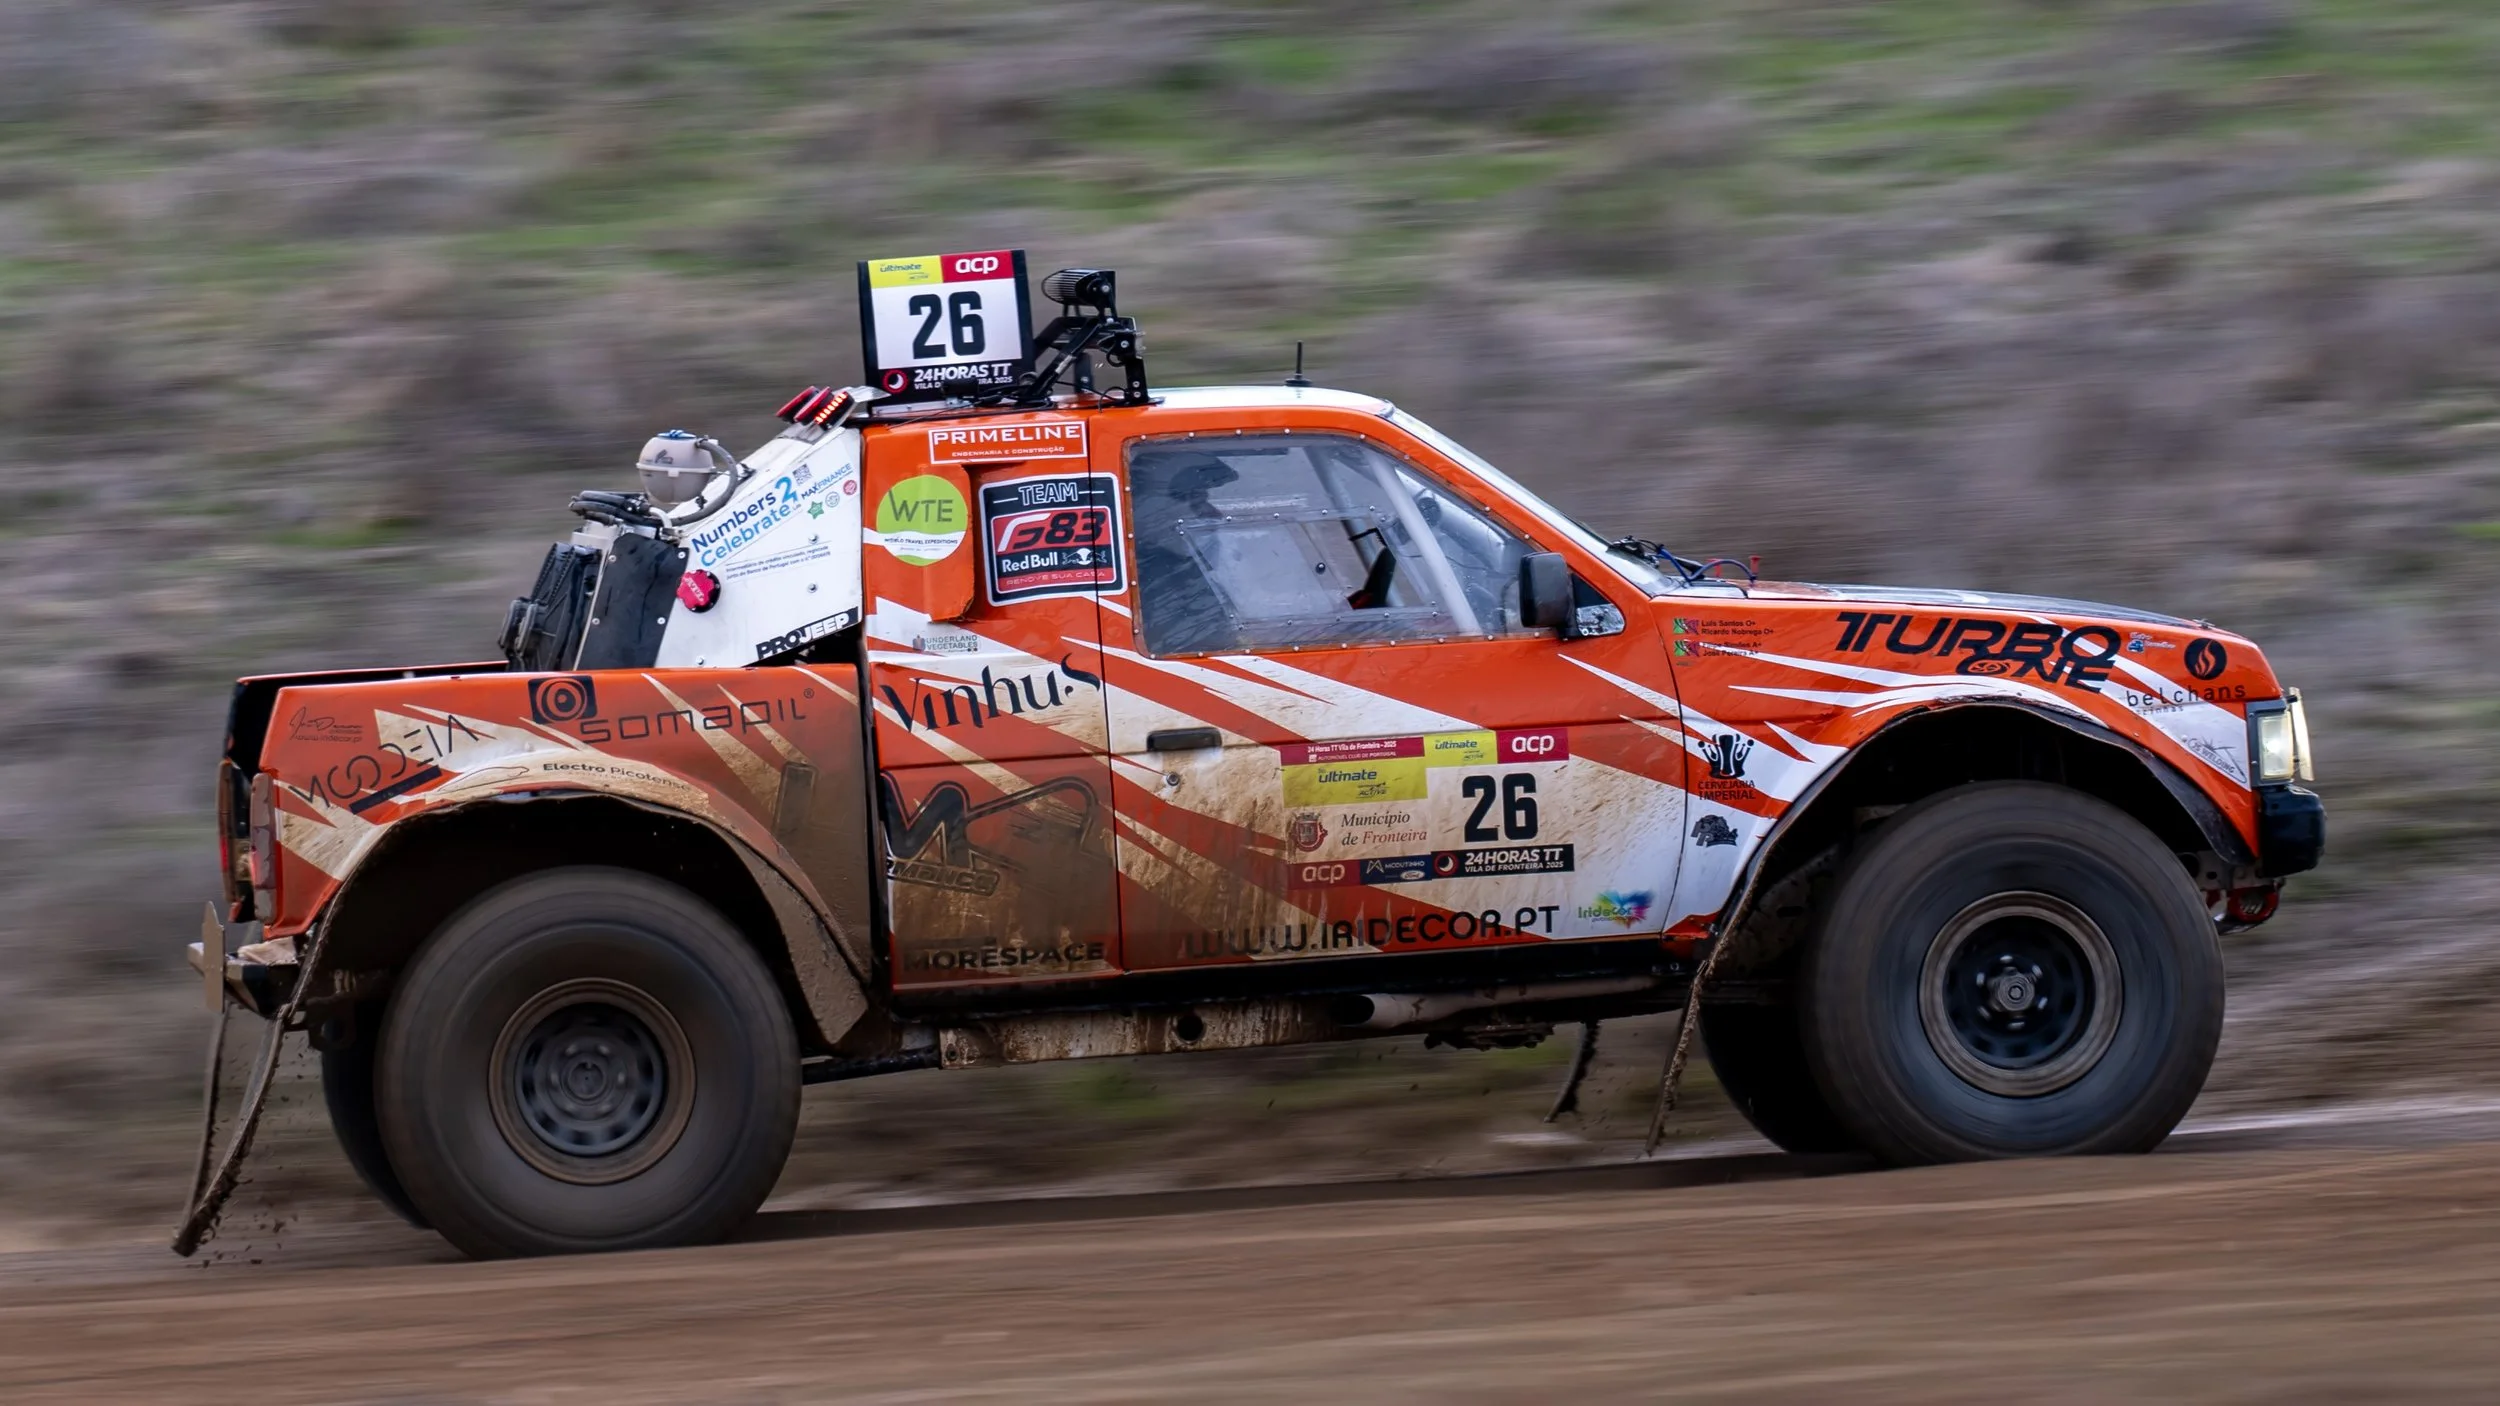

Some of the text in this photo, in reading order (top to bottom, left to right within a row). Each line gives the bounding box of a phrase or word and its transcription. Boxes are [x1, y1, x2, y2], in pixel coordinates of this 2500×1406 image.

[955, 255, 999, 275] acp
[908, 290, 986, 360] 26
[914, 364, 989, 383] 24HORAS
[991, 363, 1012, 377] TT
[914, 382, 933, 390] VILA
[934, 424, 1081, 446] PRIMELINE
[952, 449, 1003, 458] ENGENHARIA
[1012, 446, 1065, 455] CONSTRUÇÃO
[801, 463, 852, 500] MAXFINANCE
[1018, 482, 1079, 506] TEAM
[692, 492, 776, 554] Numbers
[775, 475, 798, 503] 2
[887, 488, 953, 523] WTE
[701, 502, 792, 568] Celebrate
[1006, 574, 1049, 585] RENOVE
[756, 611, 850, 660] PROJEEP
[927, 642, 978, 651] VEGETABLES
[1835, 611, 2122, 694] TURBO ONE
[2126, 684, 2246, 707] belchans
[1331, 744, 1339, 752] TT
[1357, 742, 1380, 750] Fronteira
[1384, 740, 1397, 748] 2025
[1435, 739, 1478, 750] ultimate
[1511, 735, 1555, 755] acp
[2202, 747, 2236, 775] WELDING
[543, 763, 605, 773] Electro
[610, 766, 691, 792] Picotense
[1318, 769, 1378, 783] ultimate
[1698, 779, 1756, 790] CERVEJARIA
[1699, 789, 1757, 801] IMPERIAL
[1462, 773, 1539, 842] 26
[1341, 811, 1411, 829] Município
[1341, 828, 1428, 846] de Fronteira
[1465, 848, 1564, 866] 24HORAS TT
[1465, 860, 1564, 873] VILA DE FRONTEIRA 2025
[1302, 863, 1346, 885] acp
